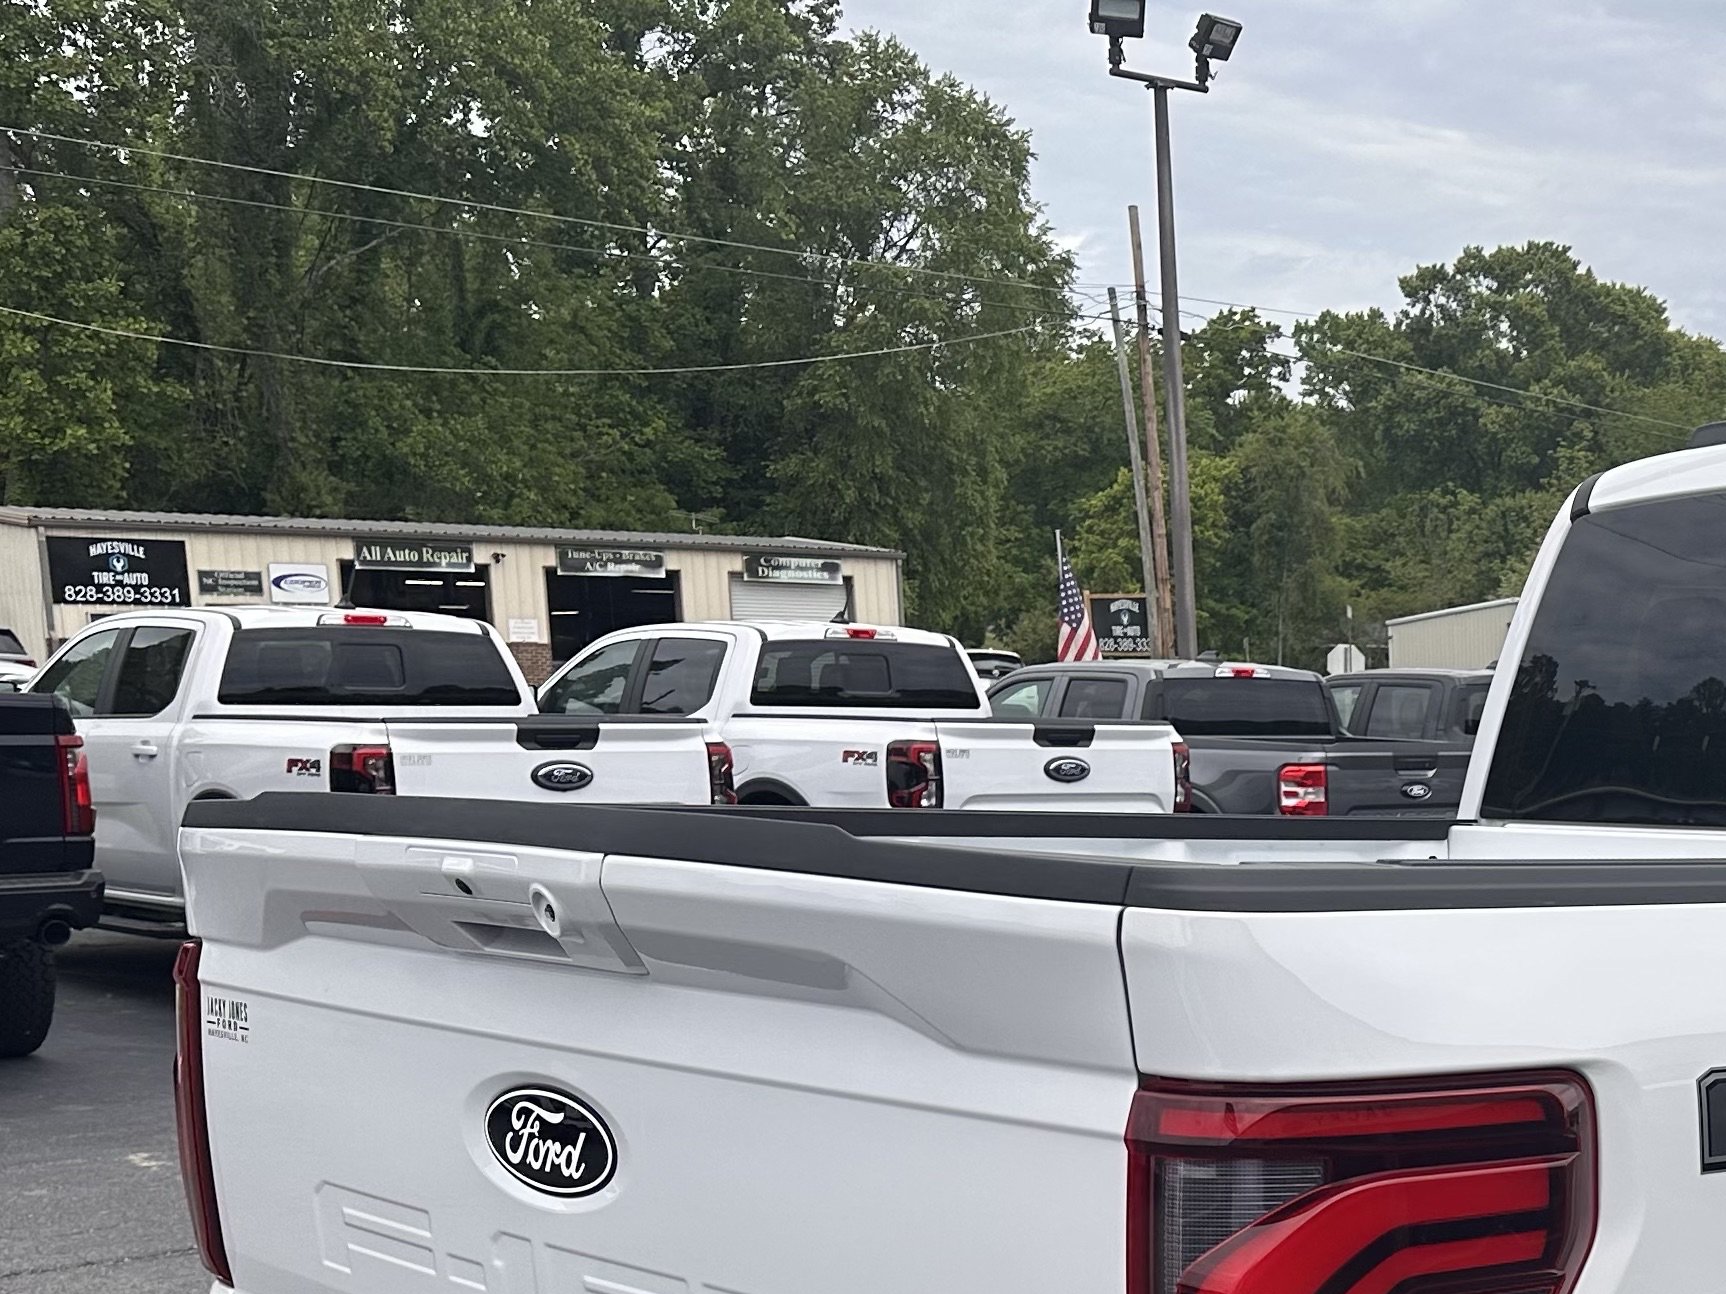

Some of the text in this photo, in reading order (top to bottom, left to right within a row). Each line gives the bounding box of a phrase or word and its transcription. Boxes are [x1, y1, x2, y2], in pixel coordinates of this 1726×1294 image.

[88, 541, 145, 559] HAYESVILLE
[359, 546, 469, 567] All Auto Repair
[584, 561, 602, 571] A/C
[760, 556, 821, 569] Computer
[92, 571, 149, 585] TIRE AUTO
[758, 566, 829, 580] Diagnostics
[64, 585, 180, 603] 828-389-3331
[842, 750, 878, 763] FX4
[286, 758, 322, 773] FX4
[207, 996, 248, 1022] JACKY JONES
[216, 1017, 238, 1032] FORD
[505, 1100, 587, 1180] Ford
